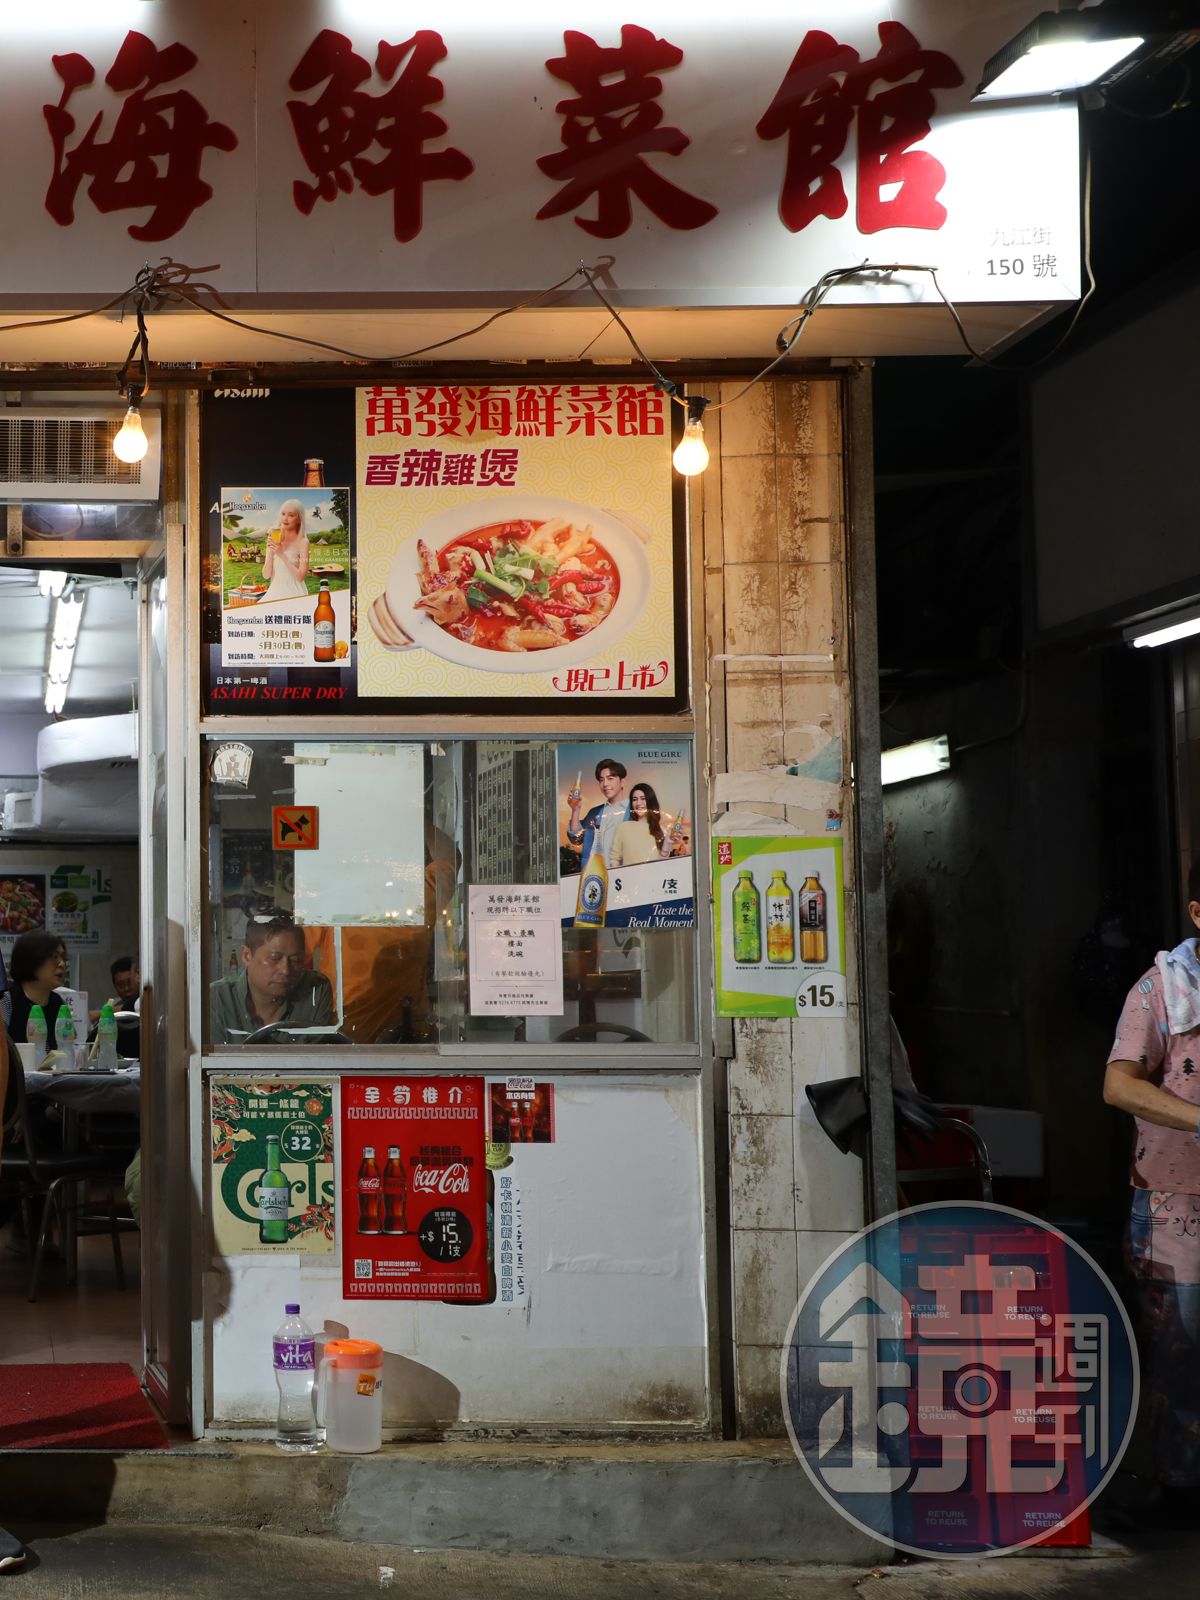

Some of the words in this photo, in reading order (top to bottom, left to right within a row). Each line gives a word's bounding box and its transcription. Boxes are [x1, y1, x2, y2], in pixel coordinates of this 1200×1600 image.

[986, 257, 1025, 276] 150
[1033, 253, 1058, 278] 號
[365, 386, 665, 437] 萬發海鮮菜館
[364, 448, 519, 487] 香辣雞煲
[216, 676, 268, 685] 日本第一啤酒
[552, 660, 669, 692] 現已上市
[210, 687, 258, 699] ASAHI
[261, 687, 312, 699] SUPER
[316, 687, 349, 699] DRY
[615, 878, 622, 892] $
[653, 904, 675, 916] Taste
[676, 903, 694, 915] the
[628, 917, 650, 928] Real
[654, 917, 694, 928] Moment
[807, 984, 835, 1008] 15
[291, 1136, 312, 1150] 32
[413, 1163, 470, 1195] Coca-Cola
[1006, 1305, 1044, 1313] RETURN
[1015, 1408, 1052, 1416] RETURN
